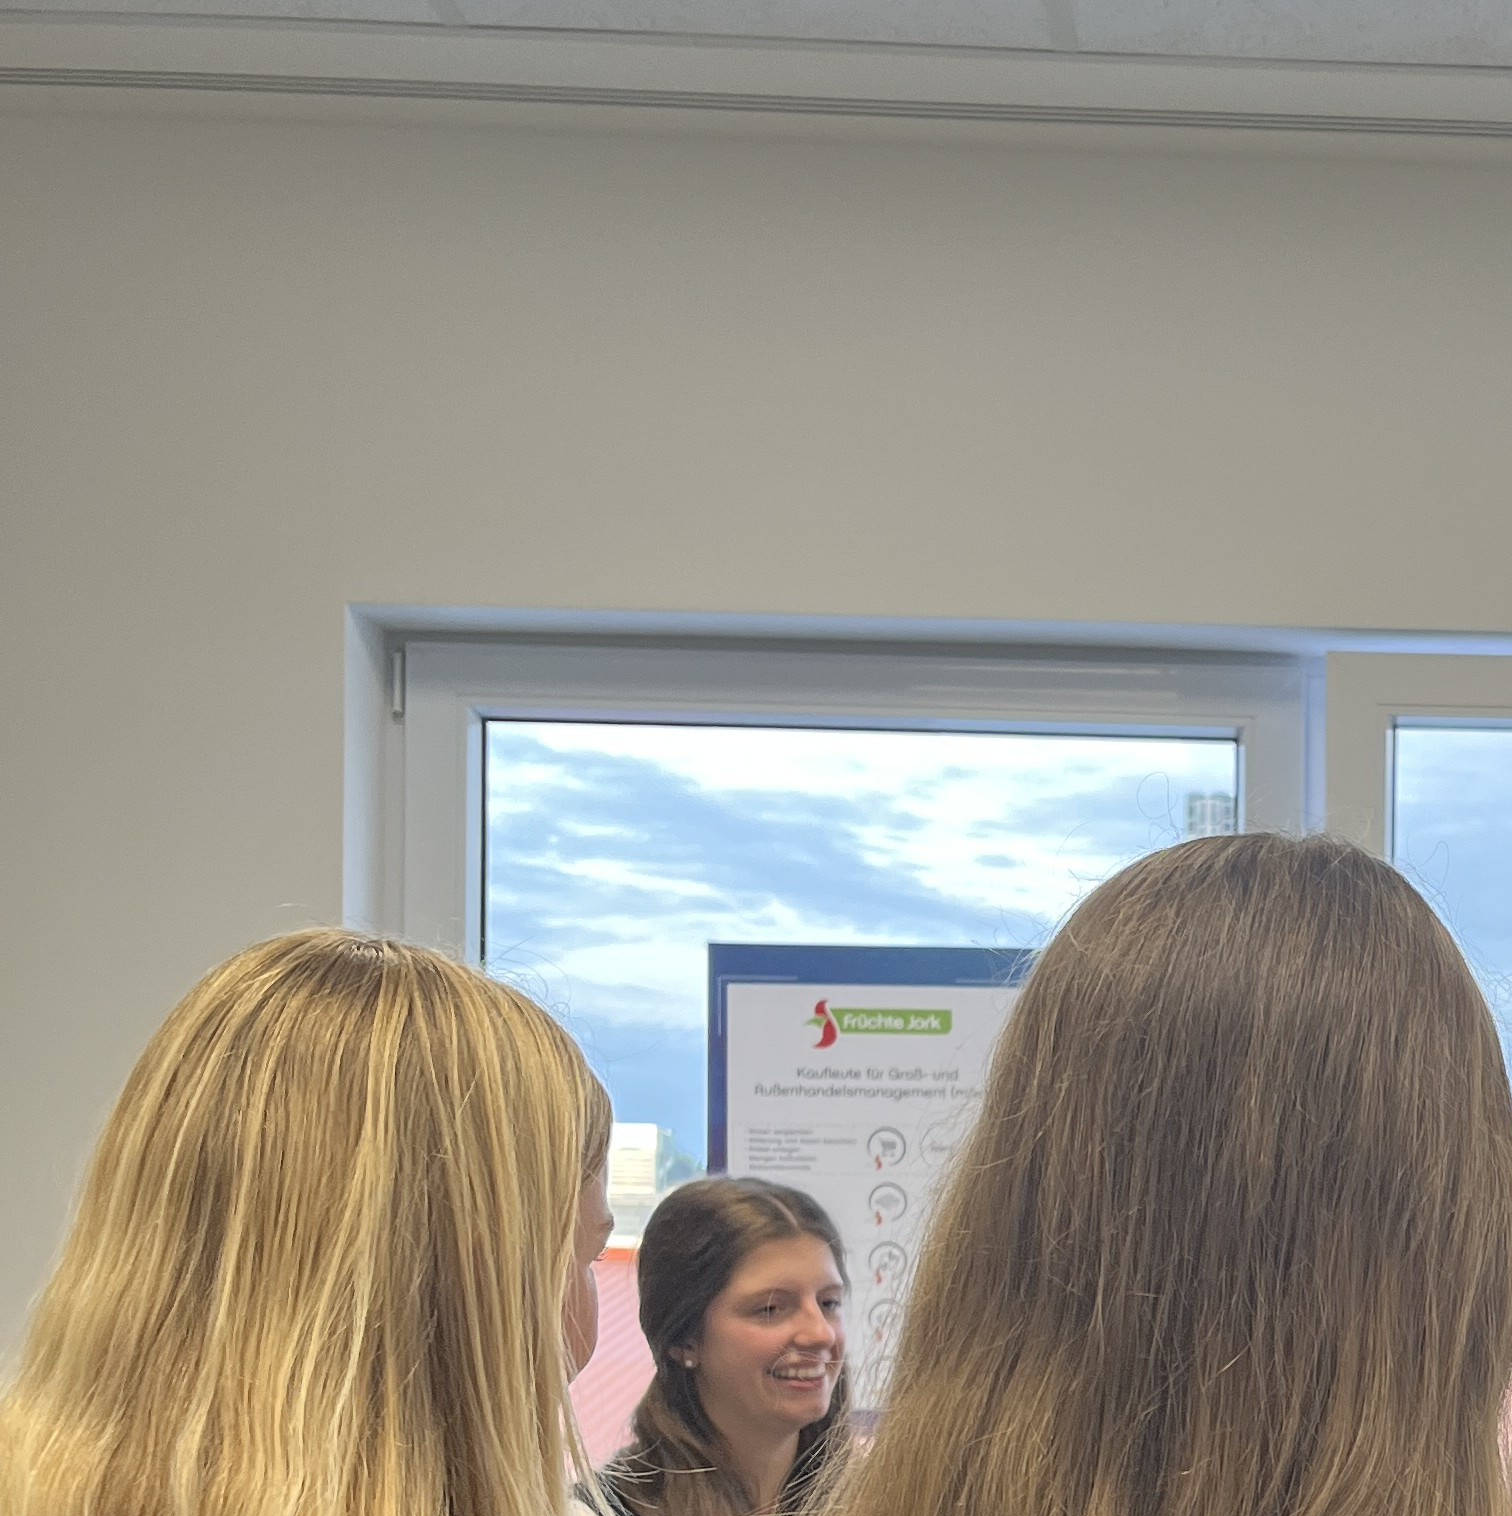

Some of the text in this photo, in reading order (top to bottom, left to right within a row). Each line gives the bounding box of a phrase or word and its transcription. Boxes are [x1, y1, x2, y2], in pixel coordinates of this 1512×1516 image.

[843, 1013, 941, 1031] Früchte Jork
[796, 1066, 862, 1081] Kaufleute
[866, 1066, 884, 1081] für
[932, 1067, 959, 1082] und
